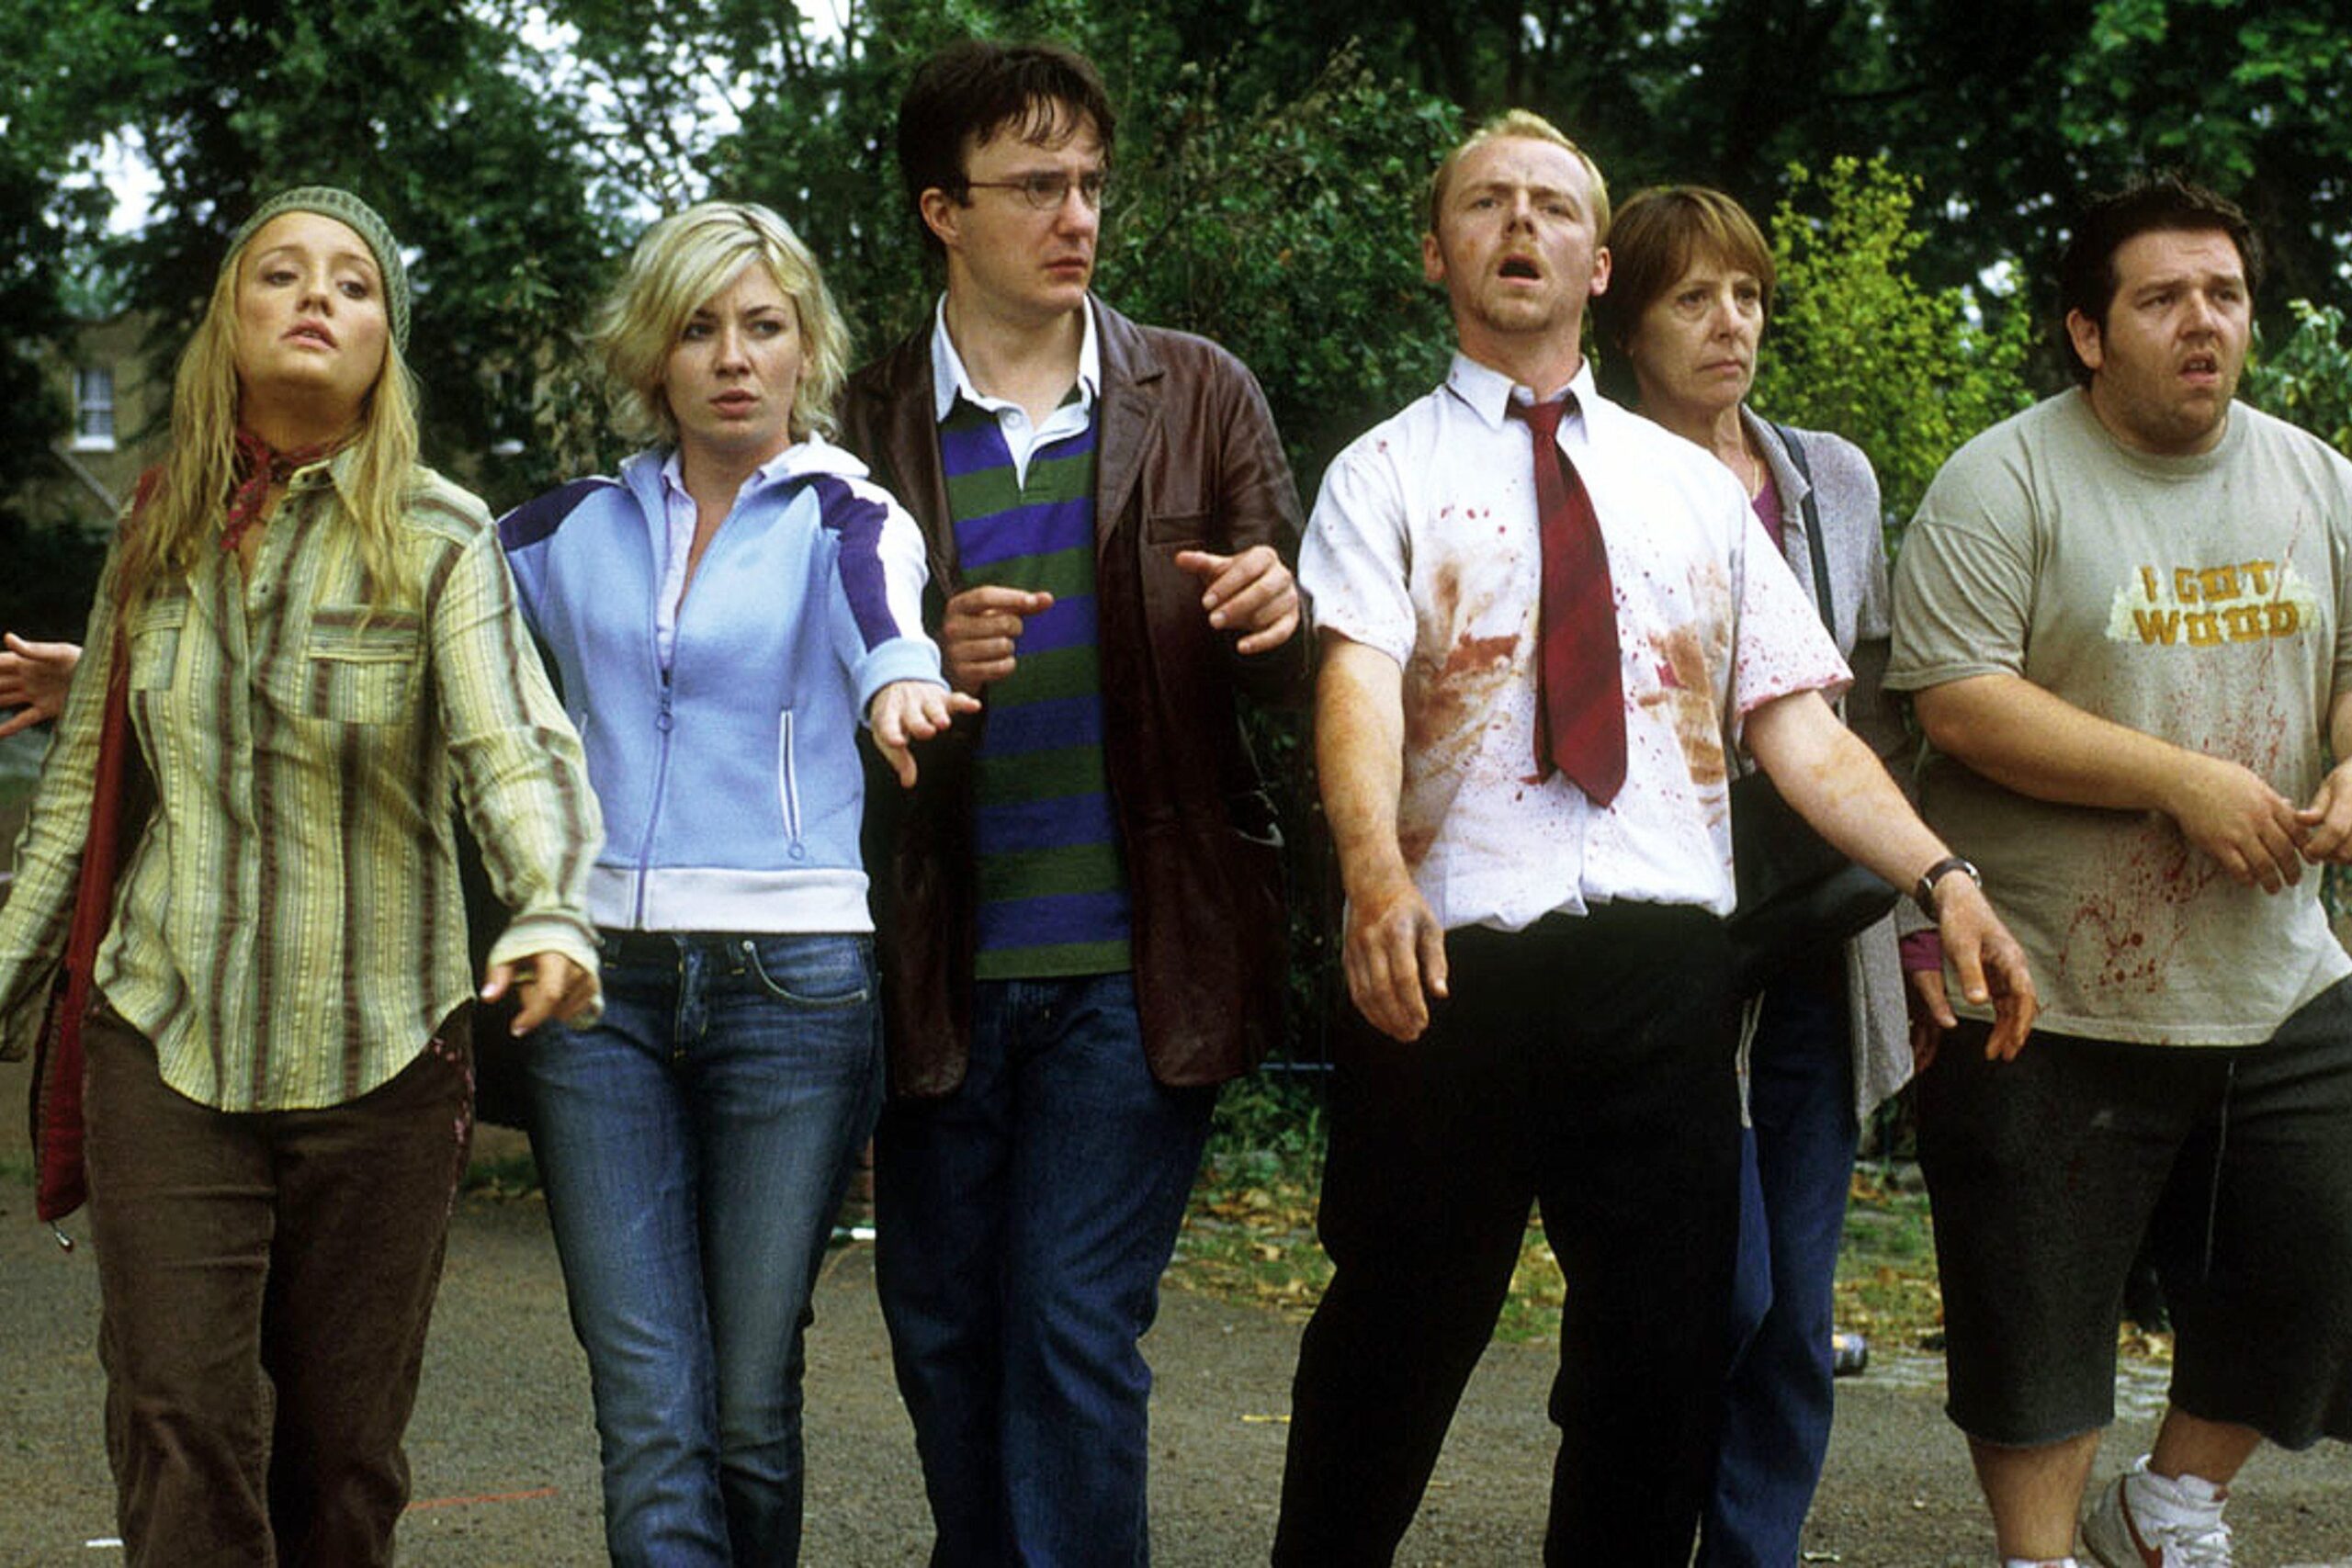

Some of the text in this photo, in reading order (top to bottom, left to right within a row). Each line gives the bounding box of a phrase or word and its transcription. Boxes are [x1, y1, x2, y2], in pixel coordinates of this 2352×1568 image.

[2142, 560, 2276, 604] I GOT
[2132, 601, 2300, 647] WOOD
